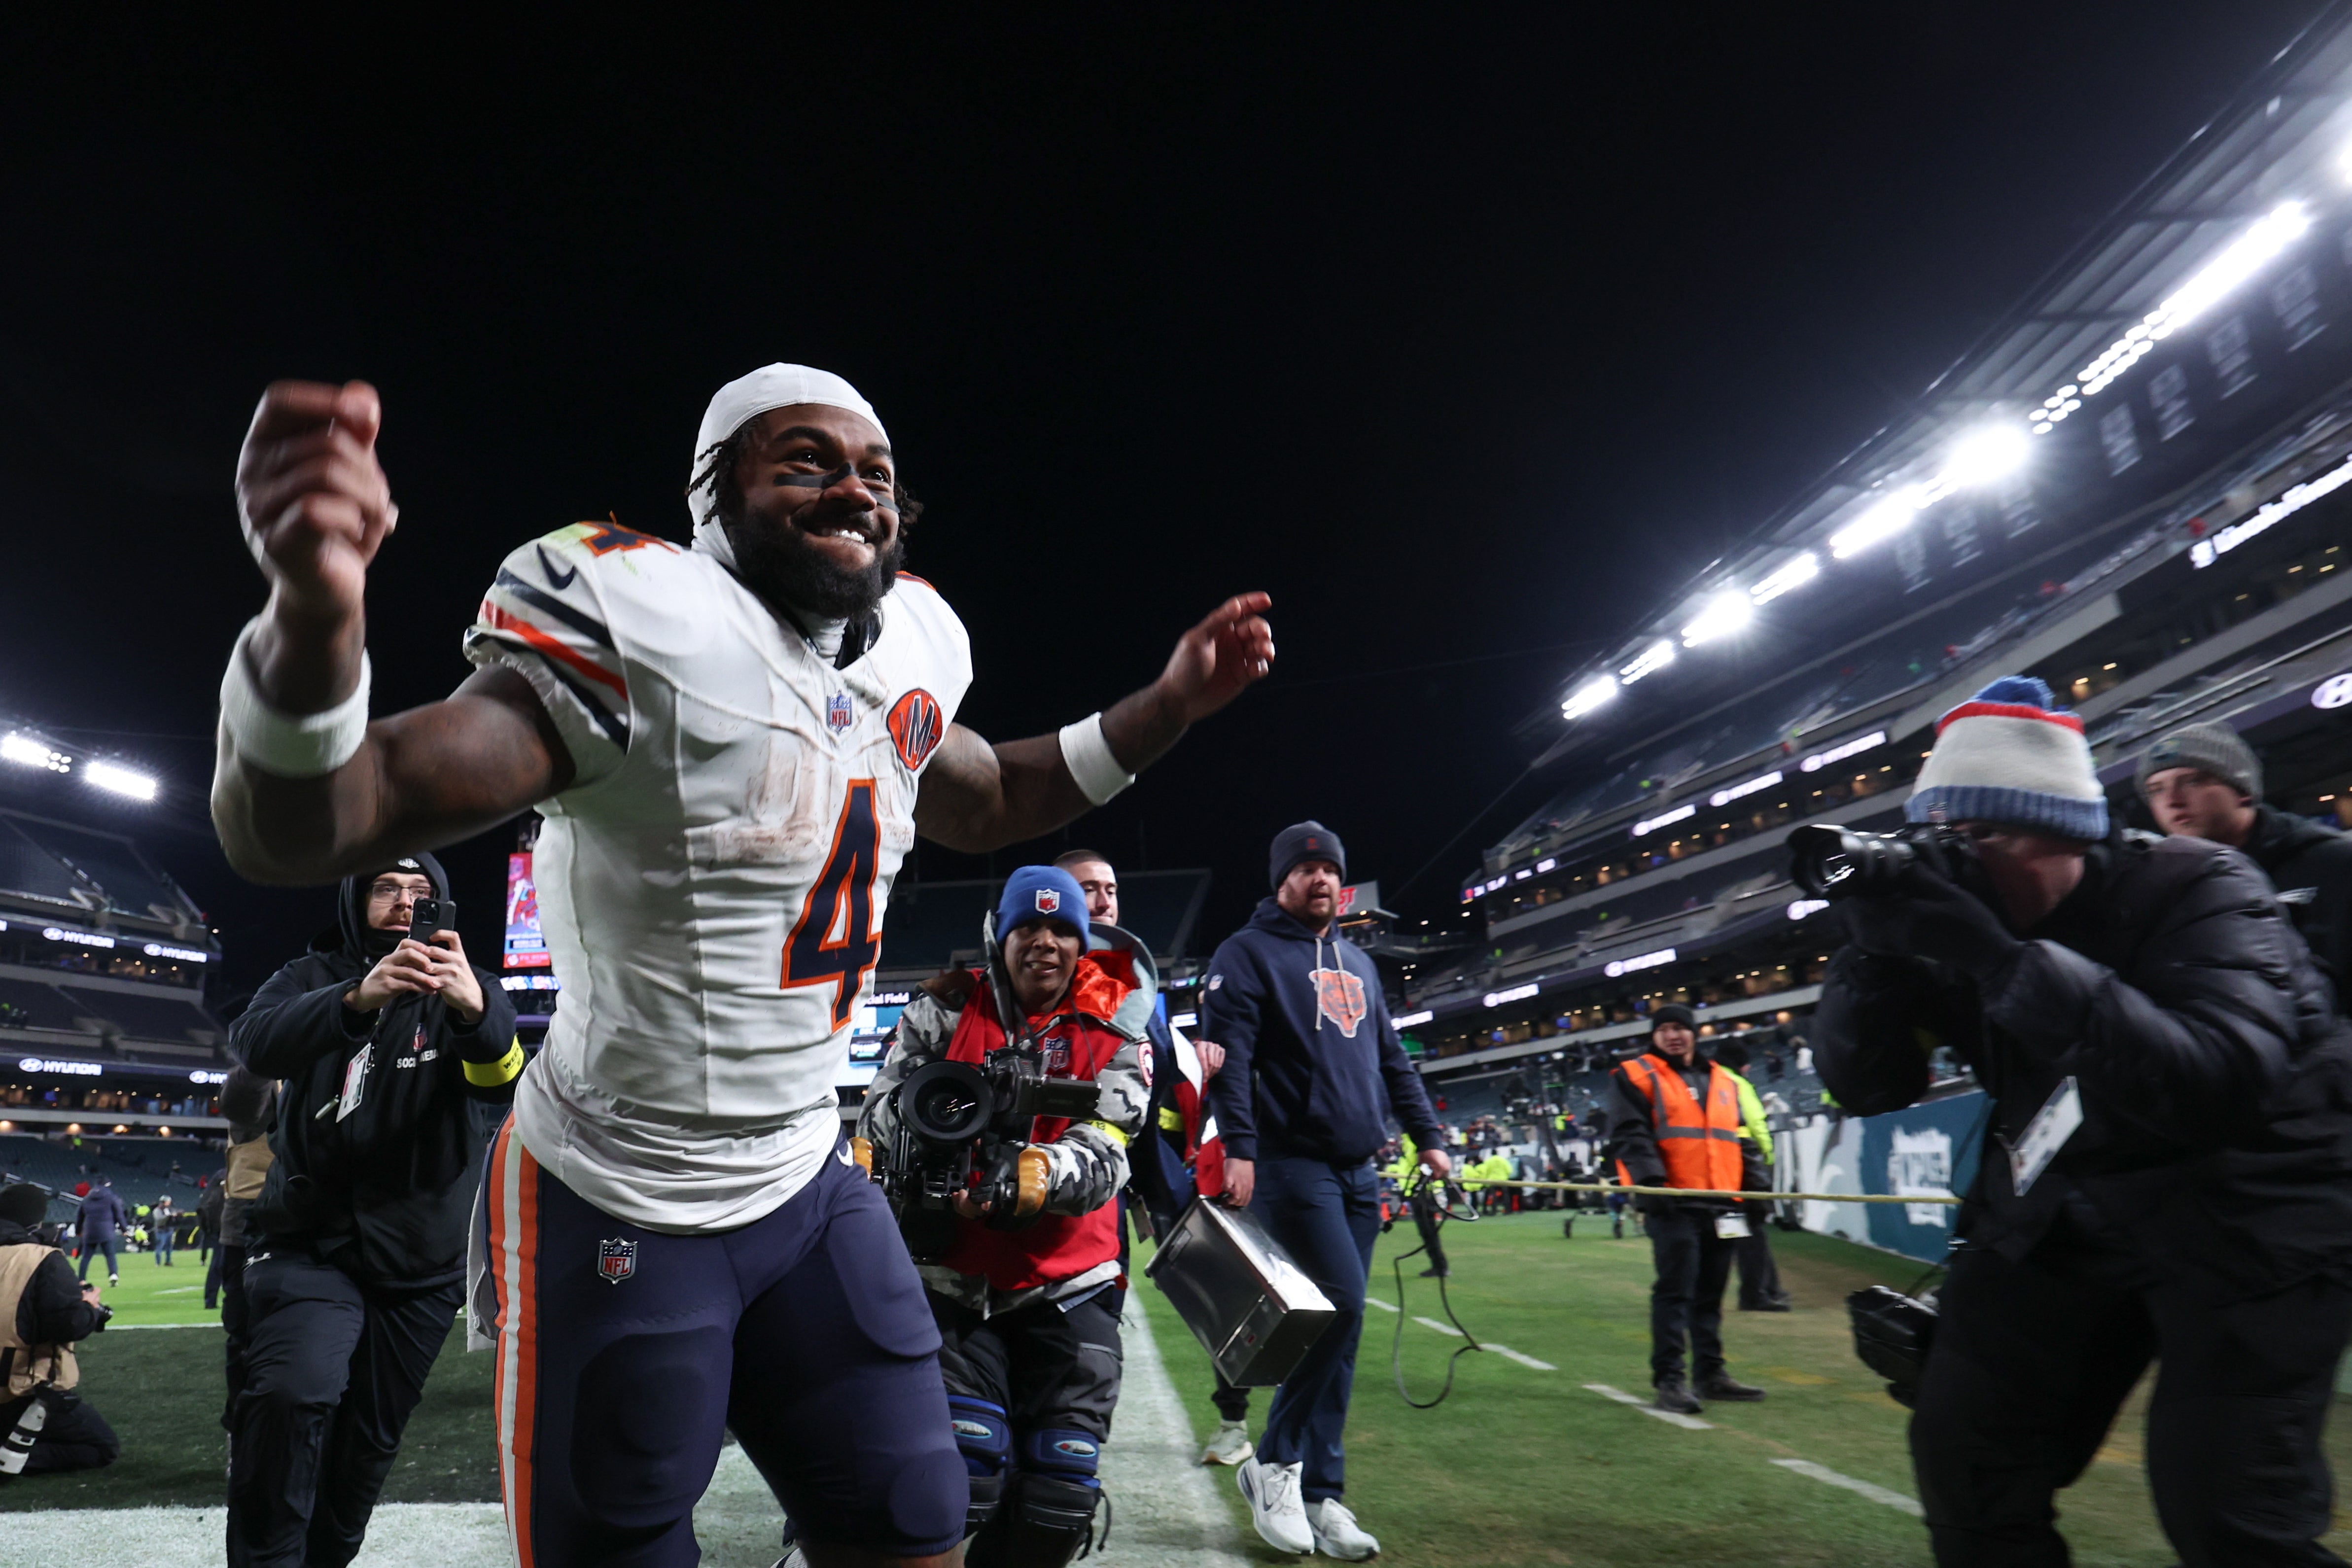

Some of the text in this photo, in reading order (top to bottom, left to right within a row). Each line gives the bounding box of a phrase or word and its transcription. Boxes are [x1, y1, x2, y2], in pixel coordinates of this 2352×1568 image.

[1337, 887, 1357, 904] ST
[780, 779, 882, 1033] 4
[867, 992, 909, 1005] cial Field
[43, 1060, 102, 1076] HYUNDAI
